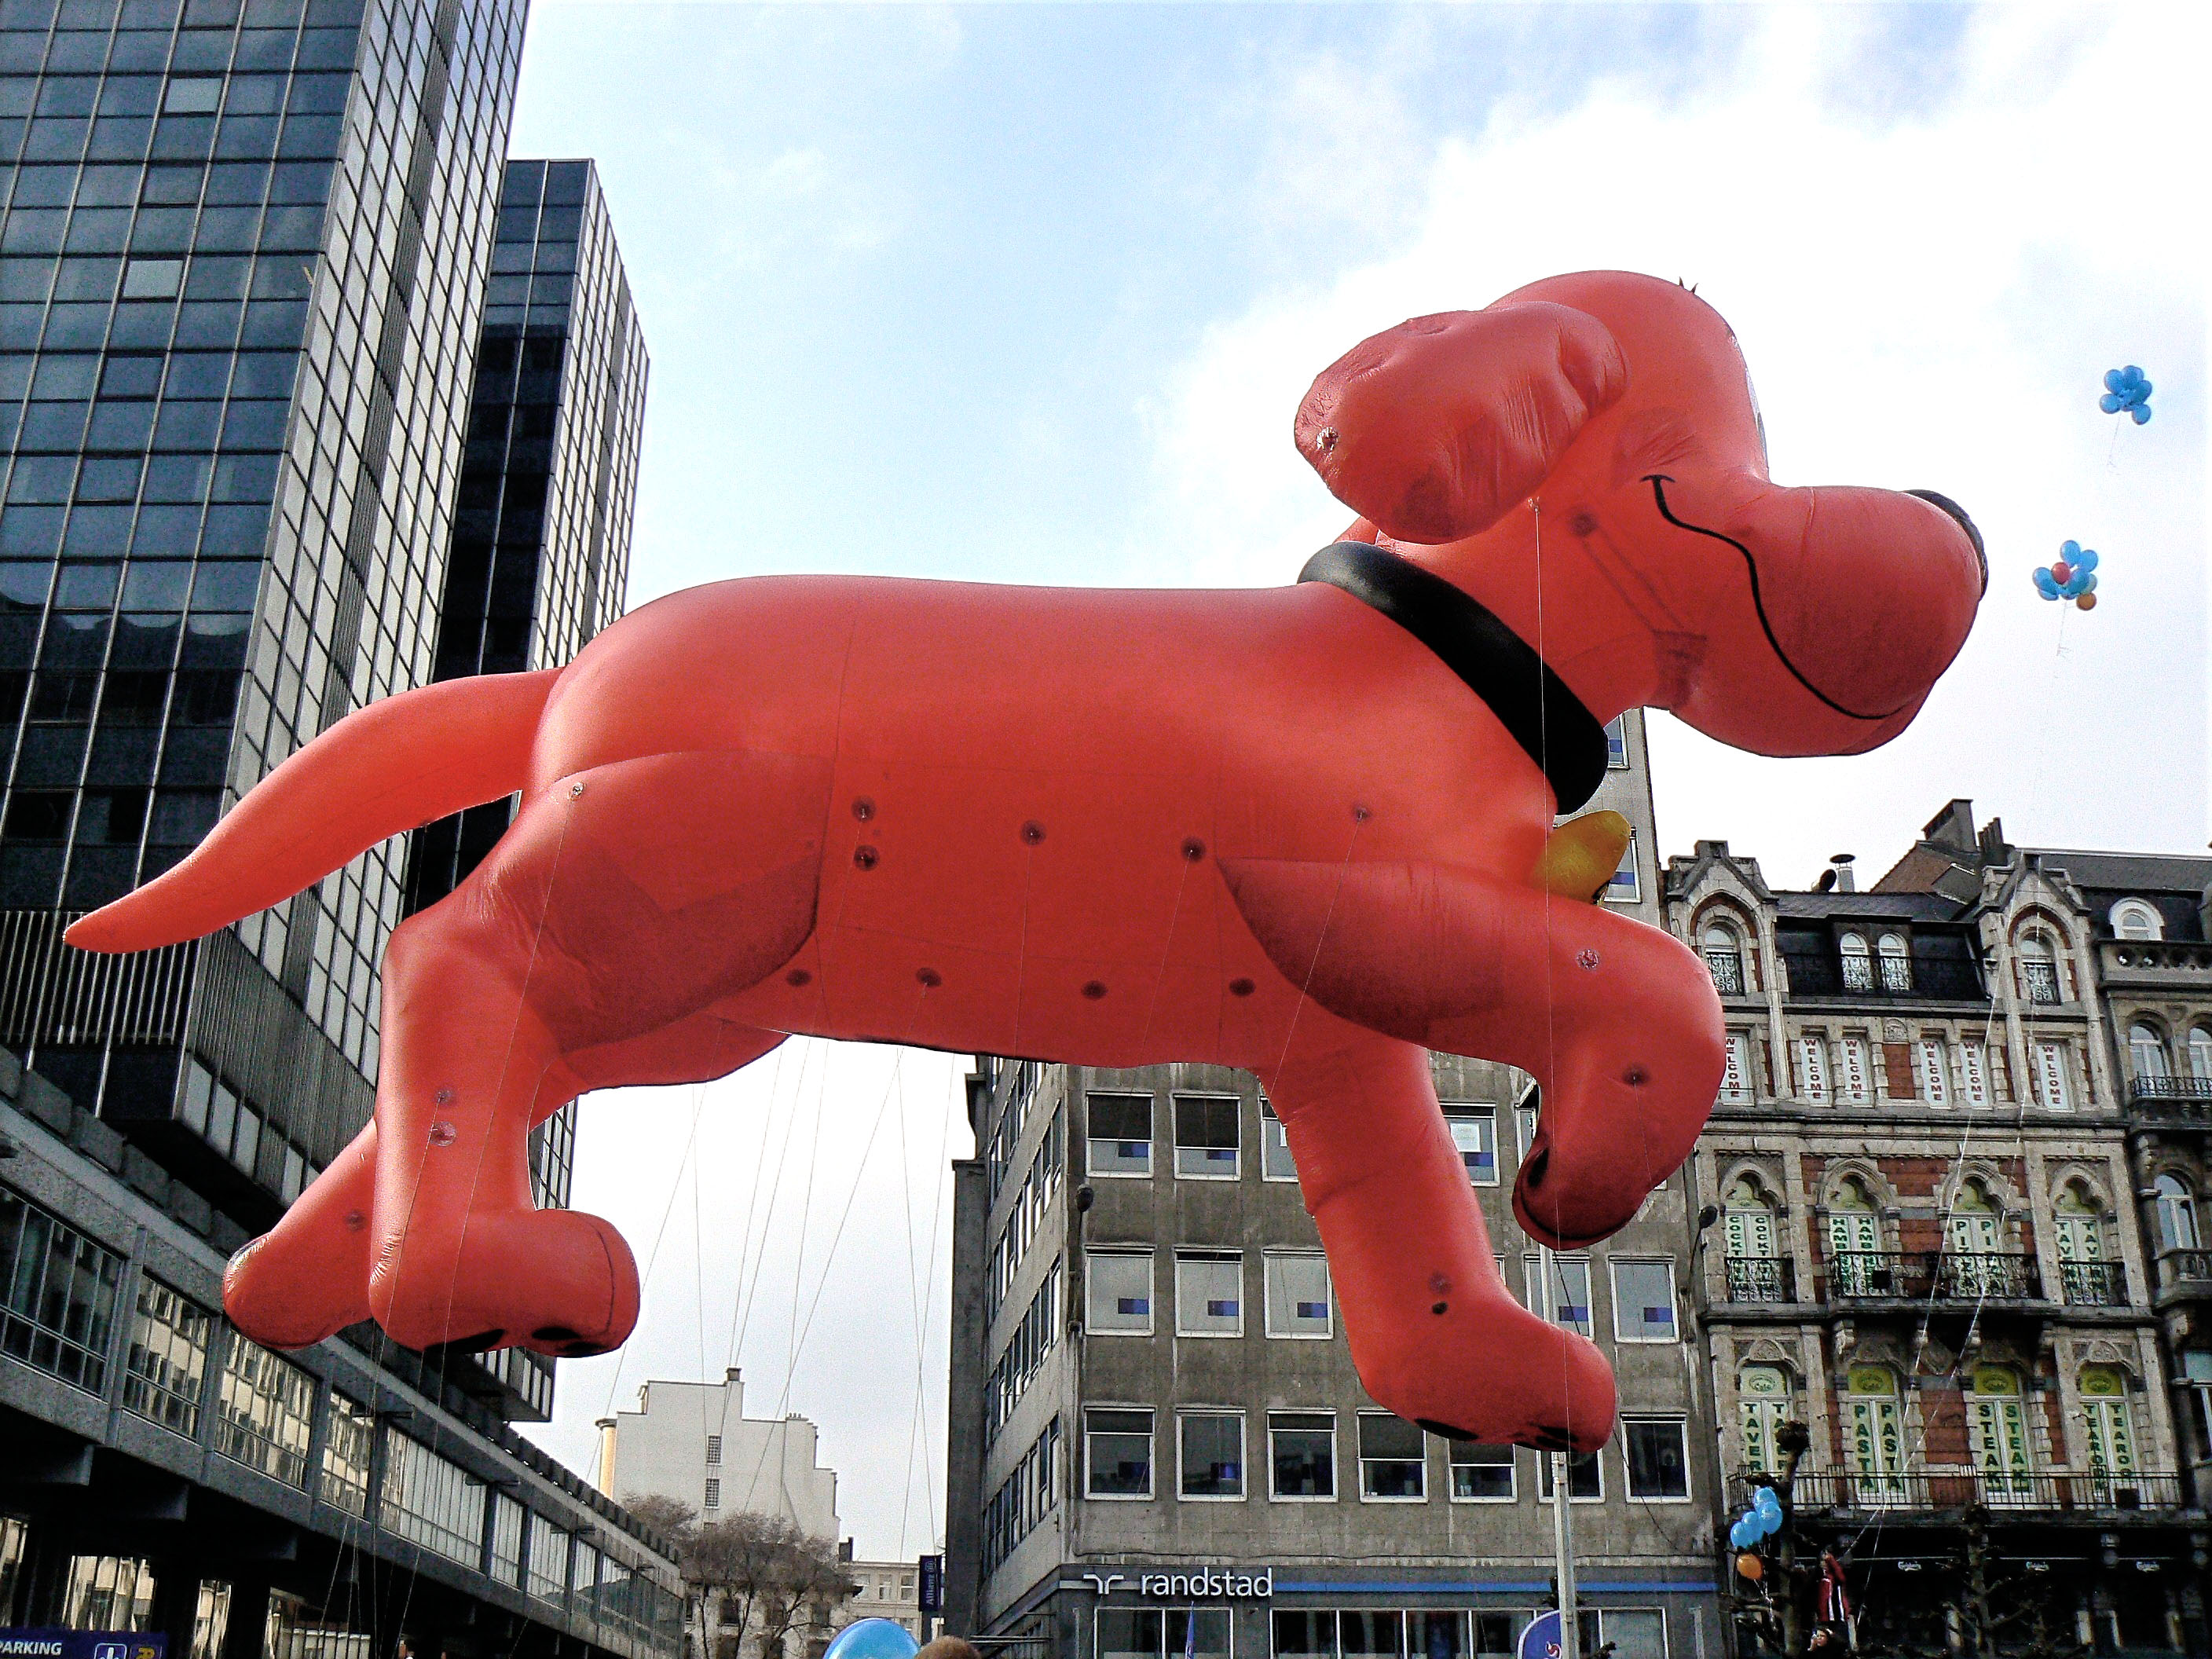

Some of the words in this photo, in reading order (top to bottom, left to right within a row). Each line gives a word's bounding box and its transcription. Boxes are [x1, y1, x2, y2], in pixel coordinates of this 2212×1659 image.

[1726, 1038, 1740, 1097] WELCOME
[1804, 1039, 1822, 1099] WELCOME
[1846, 1040, 1862, 1100] WELCOME
[1924, 1042, 1943, 1101] WELCOME
[1965, 1042, 1983, 1101] WELCOME
[2043, 1045, 2061, 1104] WELCOME
[1855, 1404, 1873, 1489] PASTA
[1881, 1404, 1902, 1489] PASTA
[1979, 1404, 2001, 1483] STEAK
[2005, 1404, 2026, 1481] STEAK
[1141, 1566, 1273, 1597] randstad
